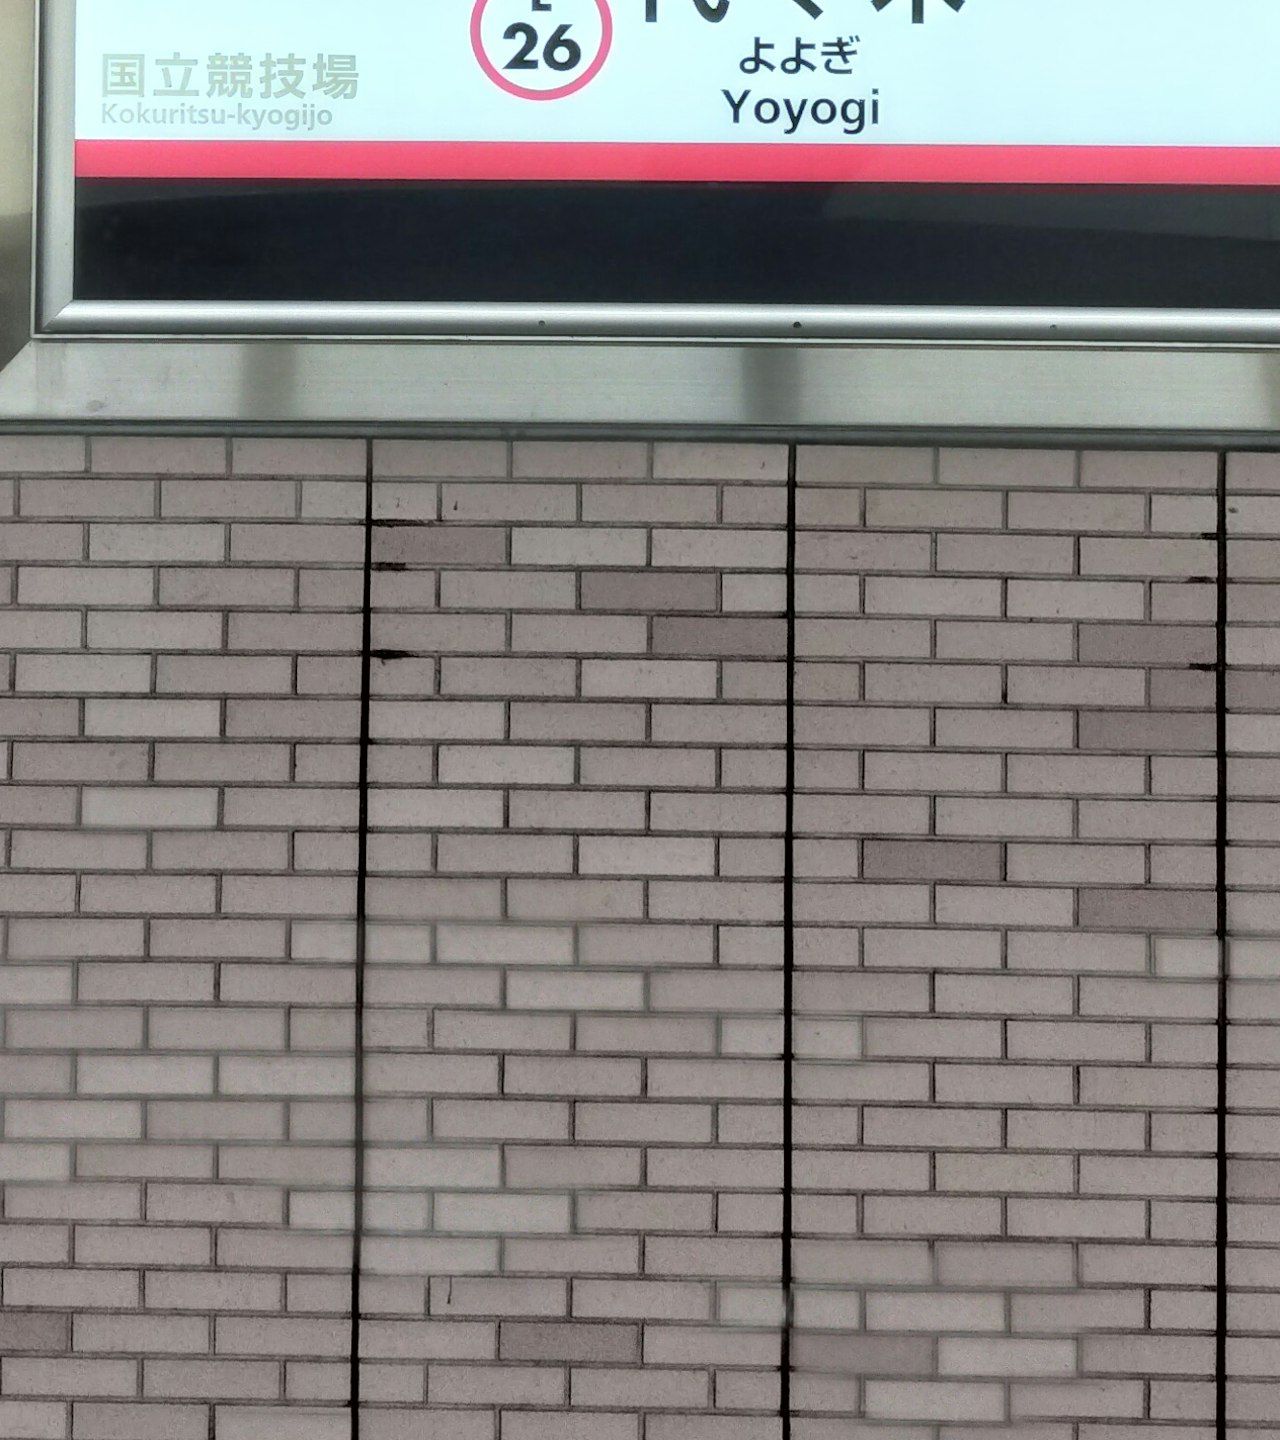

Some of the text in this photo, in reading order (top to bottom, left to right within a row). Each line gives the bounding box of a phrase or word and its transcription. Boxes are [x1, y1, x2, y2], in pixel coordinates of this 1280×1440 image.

[502, 22, 582, 72] 26
[739, 34, 861, 74] よよぎ
[102, 52, 359, 100] 国立競技場
[101, 102, 333, 131] Kokuritsu-kyogijo
[721, 88, 879, 134] Yoyogi
